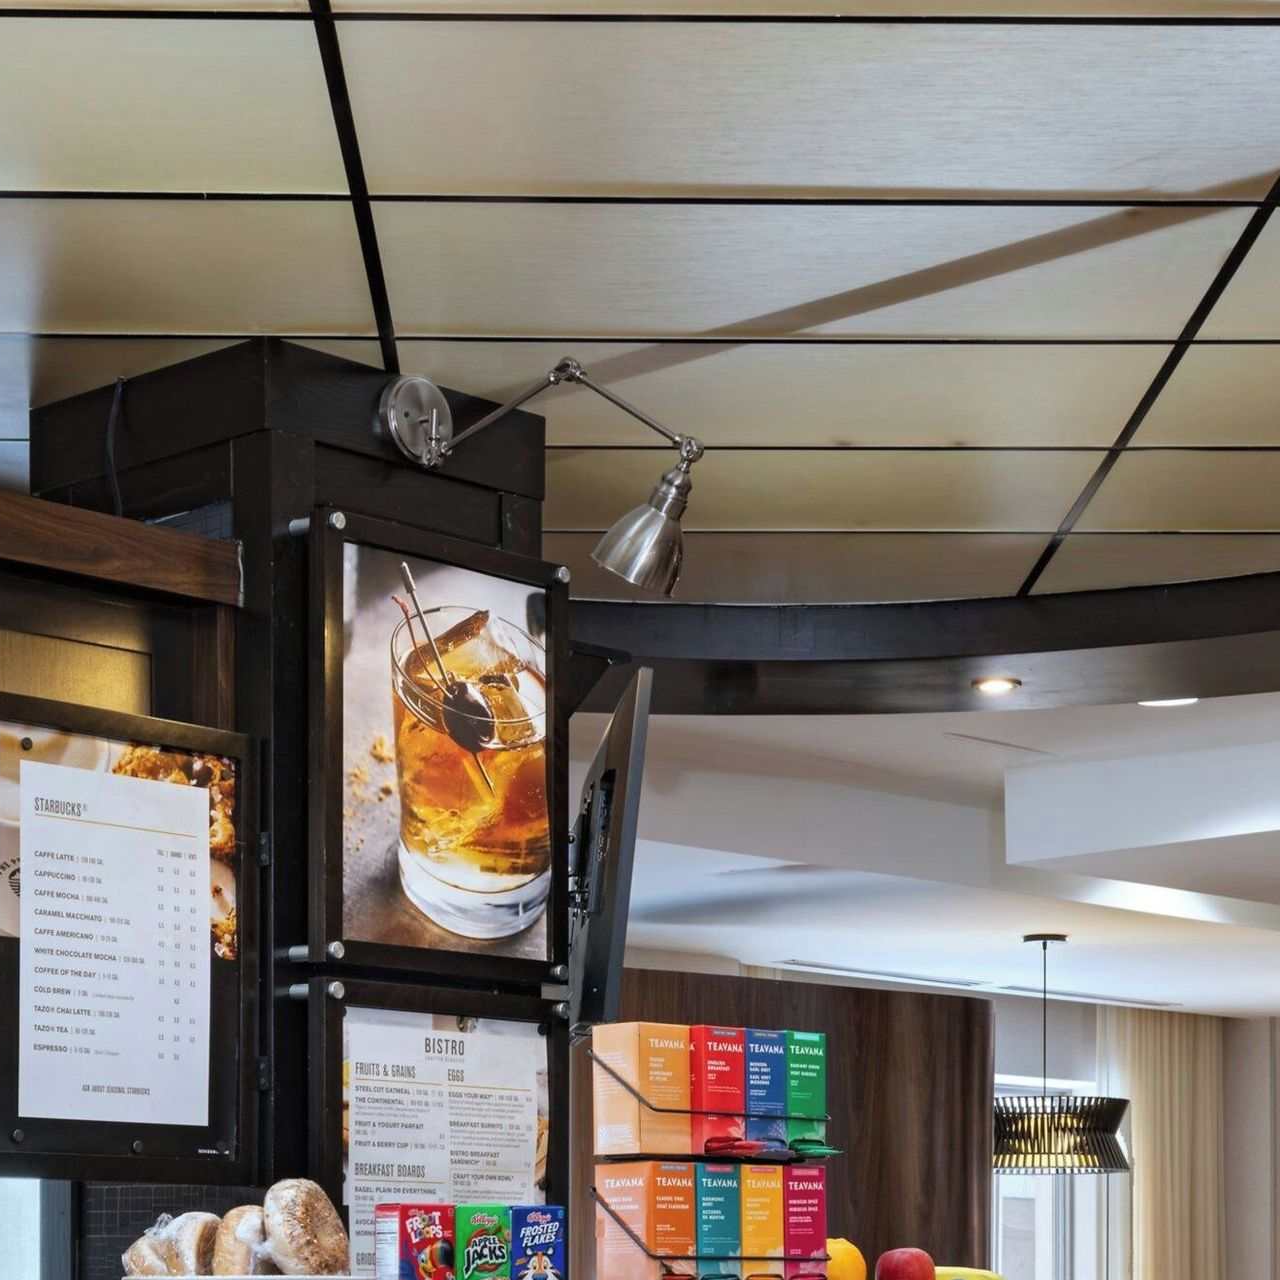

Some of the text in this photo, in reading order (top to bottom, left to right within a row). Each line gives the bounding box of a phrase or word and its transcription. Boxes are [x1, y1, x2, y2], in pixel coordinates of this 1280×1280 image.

[56, 853, 75, 862] LATTE
[34, 869, 76, 881] CAPPUCCINO
[56, 891, 80, 901] MOCHA
[34, 908, 64, 918] CARAMEL
[65, 911, 102, 922] MACCHIATO
[56, 930, 93, 940] AMERICANO
[34, 947, 54, 956] WHITE
[56, 949, 92, 960] CHOCOLATE
[93, 952, 117, 962] MOCHA
[34, 966, 59, 976] COFFEE
[60, 968, 69, 976] OF
[70, 969, 83, 978] THE
[83, 970, 96, 979] DAY
[34, 985, 52, 994] COLD
[52, 987, 71, 996] BREW
[72, 1008, 91, 1017] LATTE
[56, 1025, 68, 1033] TEA
[34, 1043, 67, 1053] ESPRESSO
[424, 1037, 465, 1056] BISTRO
[707, 1041, 743, 1053] TEAVANA
[749, 1043, 784, 1055] TEAVANA
[789, 1045, 824, 1057] TEAVANA
[355, 1062, 416, 1078] FRUITS & GRAINS
[448, 1069, 464, 1082] EGGS
[367, 1097, 405, 1105] CONTINENTAL
[355, 1162, 426, 1179] BREAKFAST BOARDS
[656, 1177, 693, 1187] TEAVANA
[702, 1178, 738, 1188] TEAVANA
[788, 1181, 824, 1191] TEAVANA
[405, 1211, 441, 1233] FROOT
[410, 1225, 443, 1244] LOOPS
[520, 1221, 559, 1238] FROSTED
[471, 1235, 497, 1249] APPLE
[522, 1232, 556, 1247] FLAKES
[464, 1245, 507, 1278] JACKS
